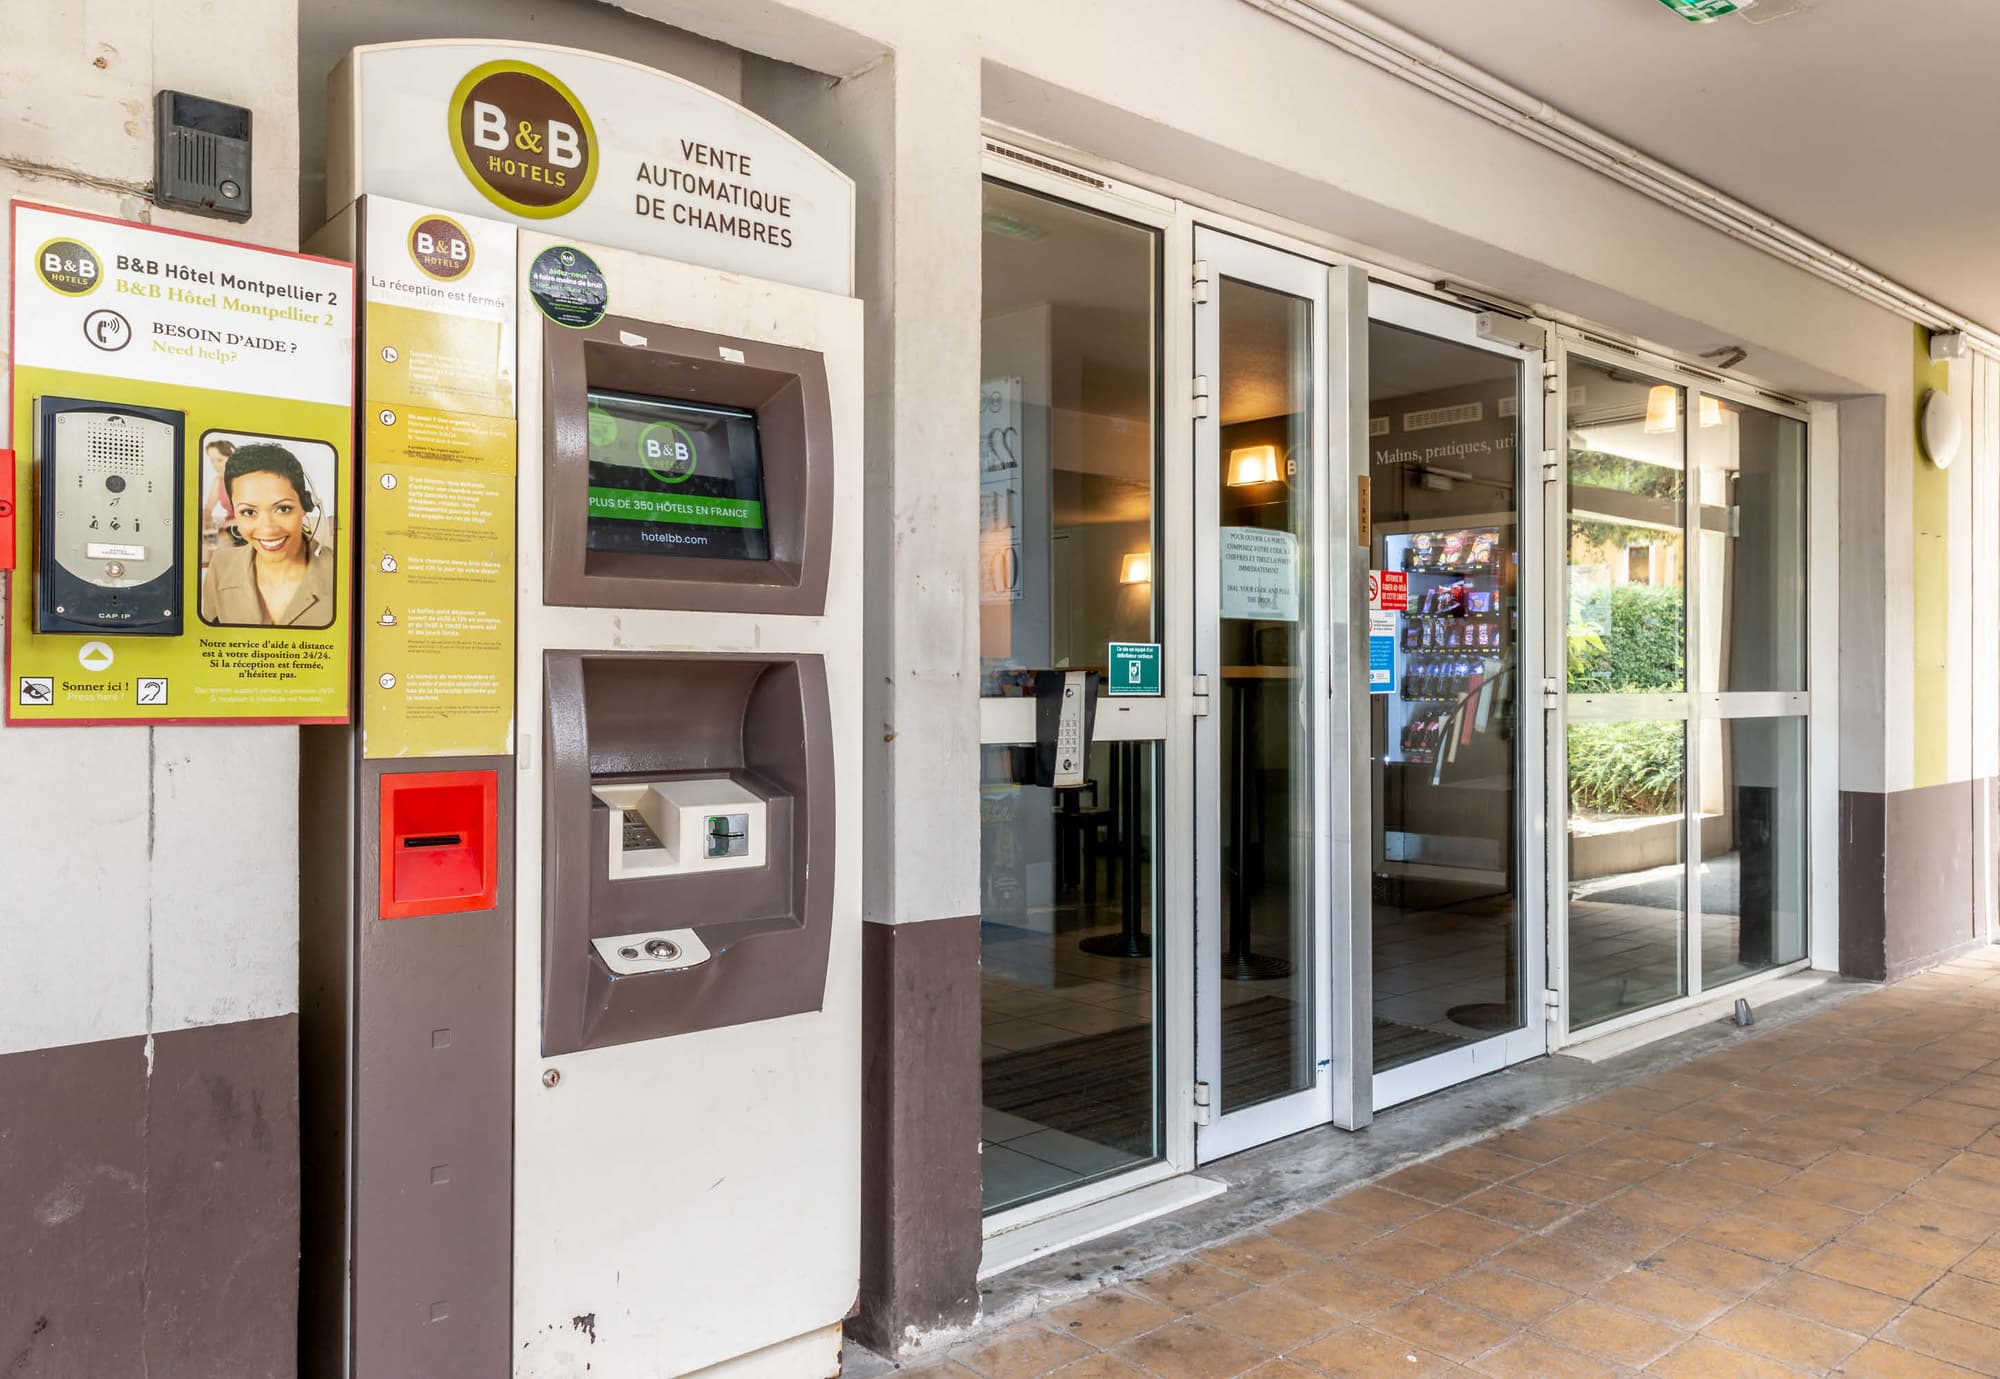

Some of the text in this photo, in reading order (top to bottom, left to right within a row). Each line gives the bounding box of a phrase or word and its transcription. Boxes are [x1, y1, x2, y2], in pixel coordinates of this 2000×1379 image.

[473, 100, 582, 169] B&B
[681, 139, 752, 177] VENTE
[488, 154, 566, 188] HOTELS
[636, 162, 791, 218] AUTOMATIQUE
[635, 194, 793, 248] DE CHAMBRES
[417, 232, 467, 261] B&B
[45, 252, 96, 279] B&B
[424, 256, 460, 269] HOTELS
[51, 273, 88, 286] HOTELS
[117, 255, 338, 306] B&B Hôtel Montpellier 2
[371, 275, 386, 288] La
[390, 279, 444, 299] réception
[447, 290, 465, 302] est
[115, 278, 334, 327] B&B Hôtel Montpellier 2
[152, 322, 222, 343] BESOIN
[290, 343, 297, 354] ?
[152, 339, 237, 364] Need help?
[646, 439, 689, 461] B&B
[1376, 448, 1423, 465] Malins,
[1425, 440, 1492, 463] pratiques,
[589, 496, 749, 519] PLUS DE 350 HÔTELS EN FRANCE
[641, 531, 708, 545] hotelbb.com
[199, 638, 227, 649] Notre
[229, 640, 260, 649] service
[291, 641, 297, 650] à
[299, 640, 334, 650] distance
[202, 649, 331, 661] est à votre disposition 24/24.
[210, 660, 324, 671] Si la réception est fermée,
[280, 671, 297, 680] pas.
[62, 681, 105, 691] Sonner
[108, 682, 122, 691] ici
[67, 692, 95, 701] Press
[98, 692, 118, 701] here
